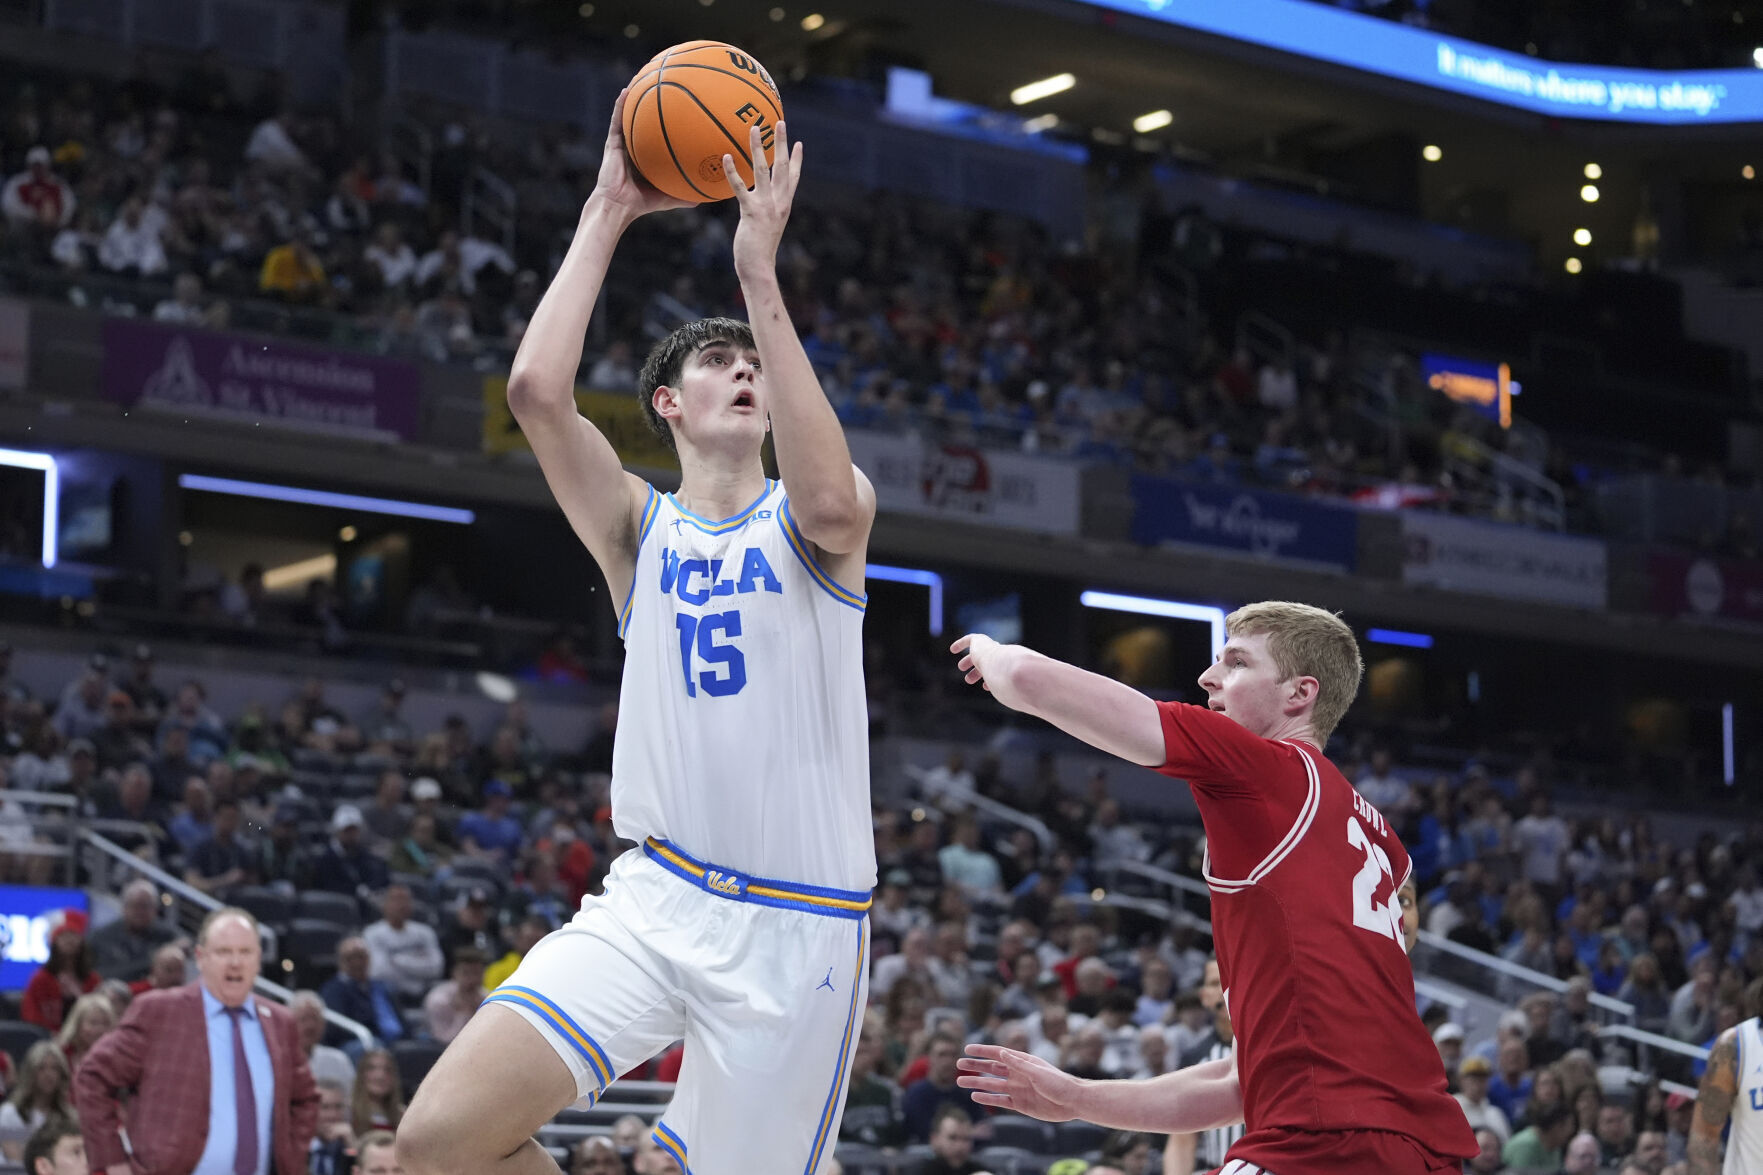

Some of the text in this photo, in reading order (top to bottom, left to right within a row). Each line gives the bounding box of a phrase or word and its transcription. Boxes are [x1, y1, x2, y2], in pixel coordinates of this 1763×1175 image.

[1533, 68, 1608, 105] where
[1608, 80, 1658, 112] you
[660, 547, 783, 607] UCLA
[675, 610, 748, 698] 15
[1351, 787, 1388, 838] CROWL
